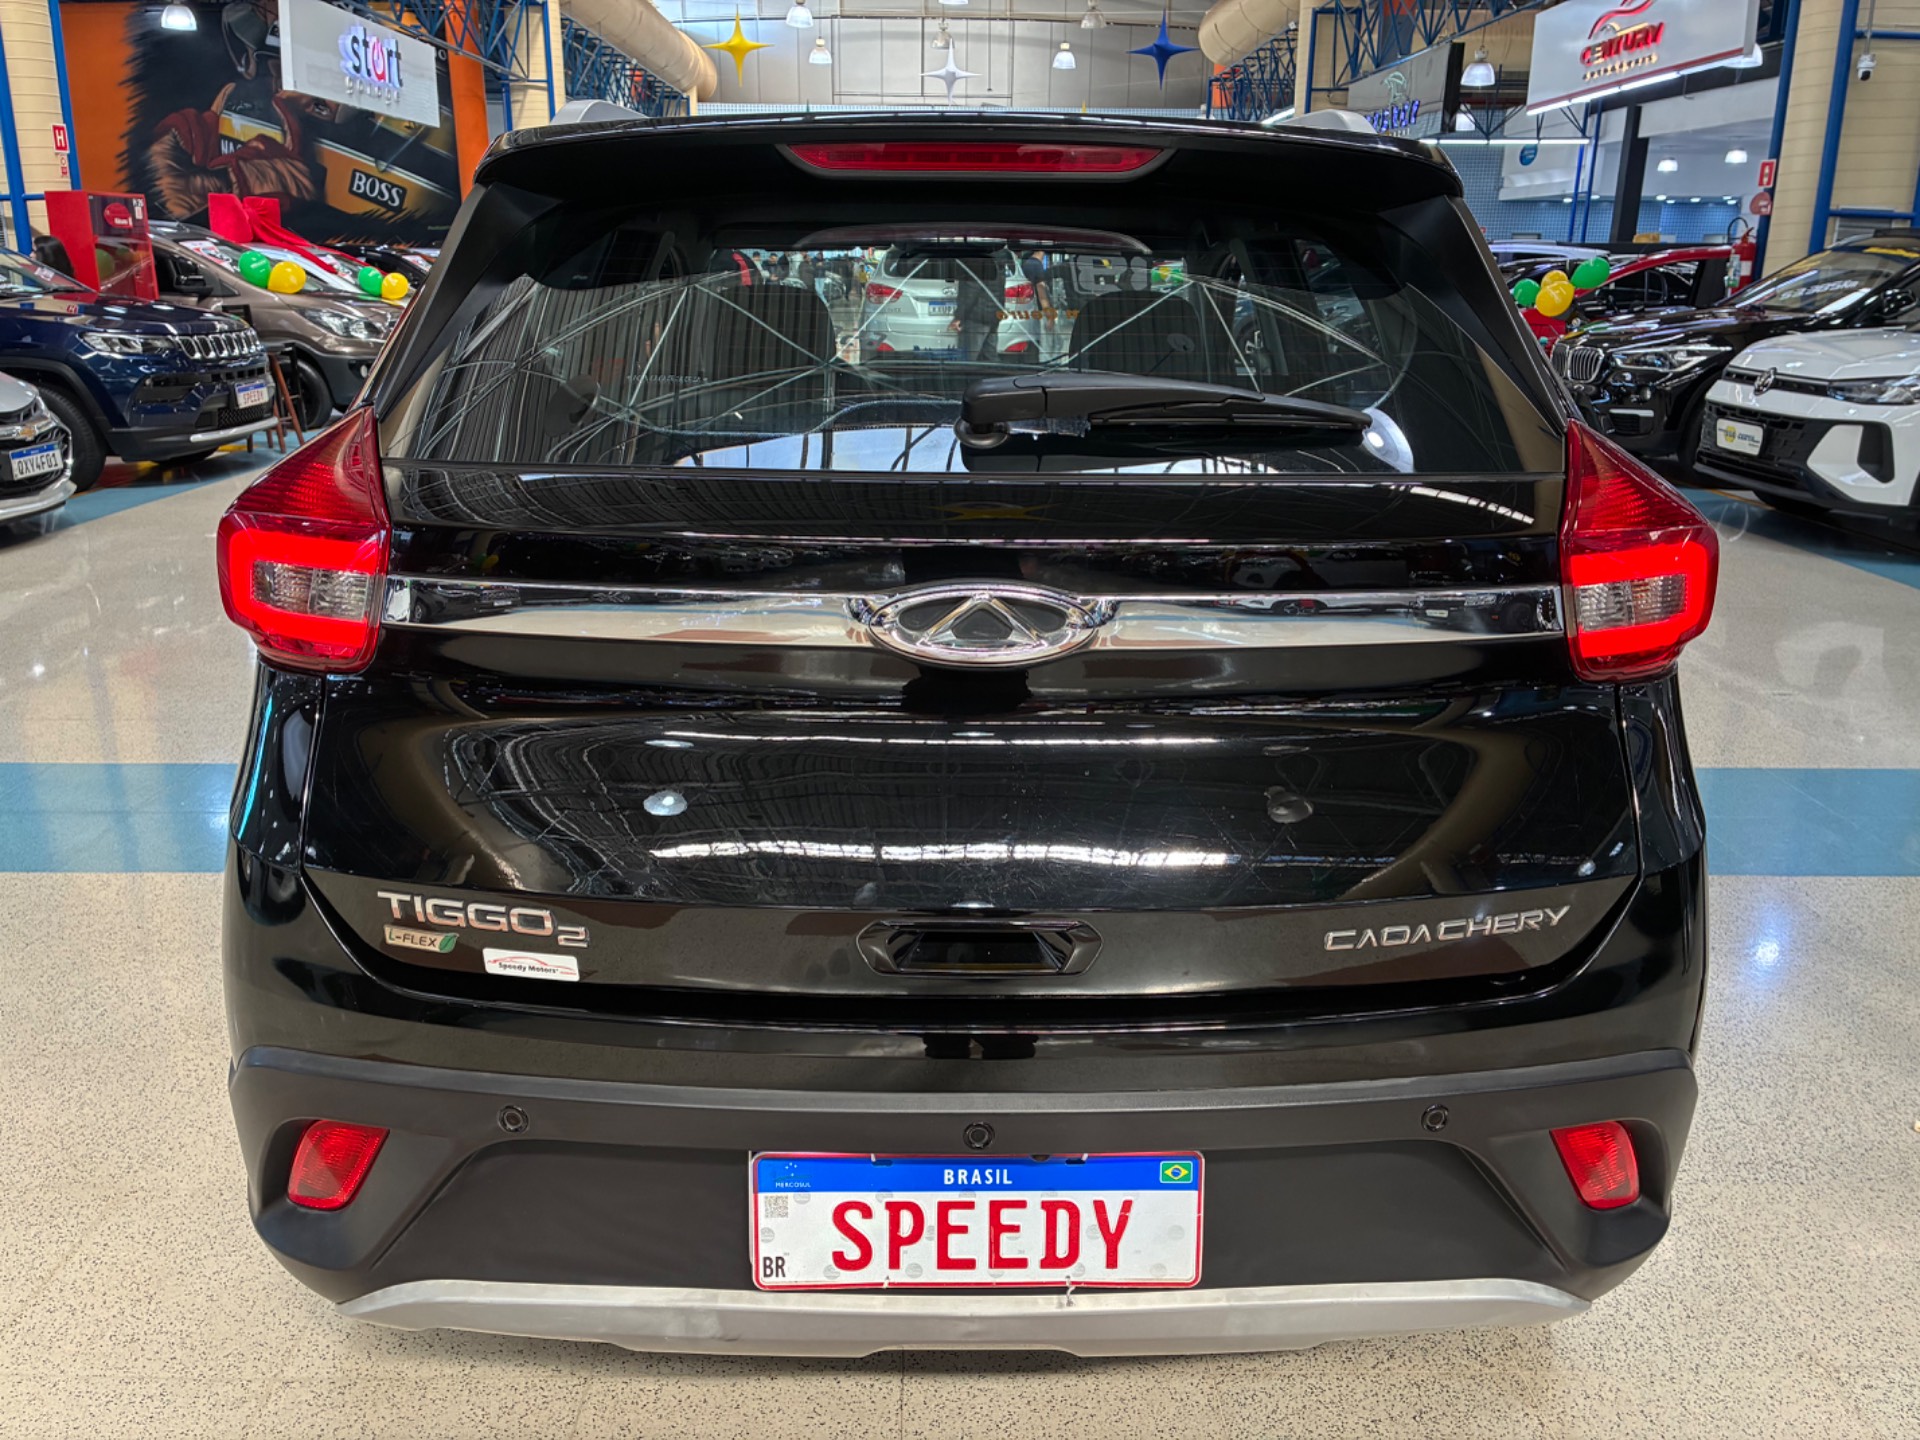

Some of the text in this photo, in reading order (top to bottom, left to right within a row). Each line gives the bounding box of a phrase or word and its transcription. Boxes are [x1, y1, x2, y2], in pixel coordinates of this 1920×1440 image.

[1580, 21, 1664, 67] CENTURY
[55, 129, 66, 148] H
[352, 171, 403, 207] BOSS
[1437, 905, 1570, 942] CHERY
[498, 961, 527, 973] Speedy
[943, 1167, 1014, 1185] BRASIL
[831, 1199, 1133, 1272] SPEEDY
[762, 1255, 786, 1279] BR
